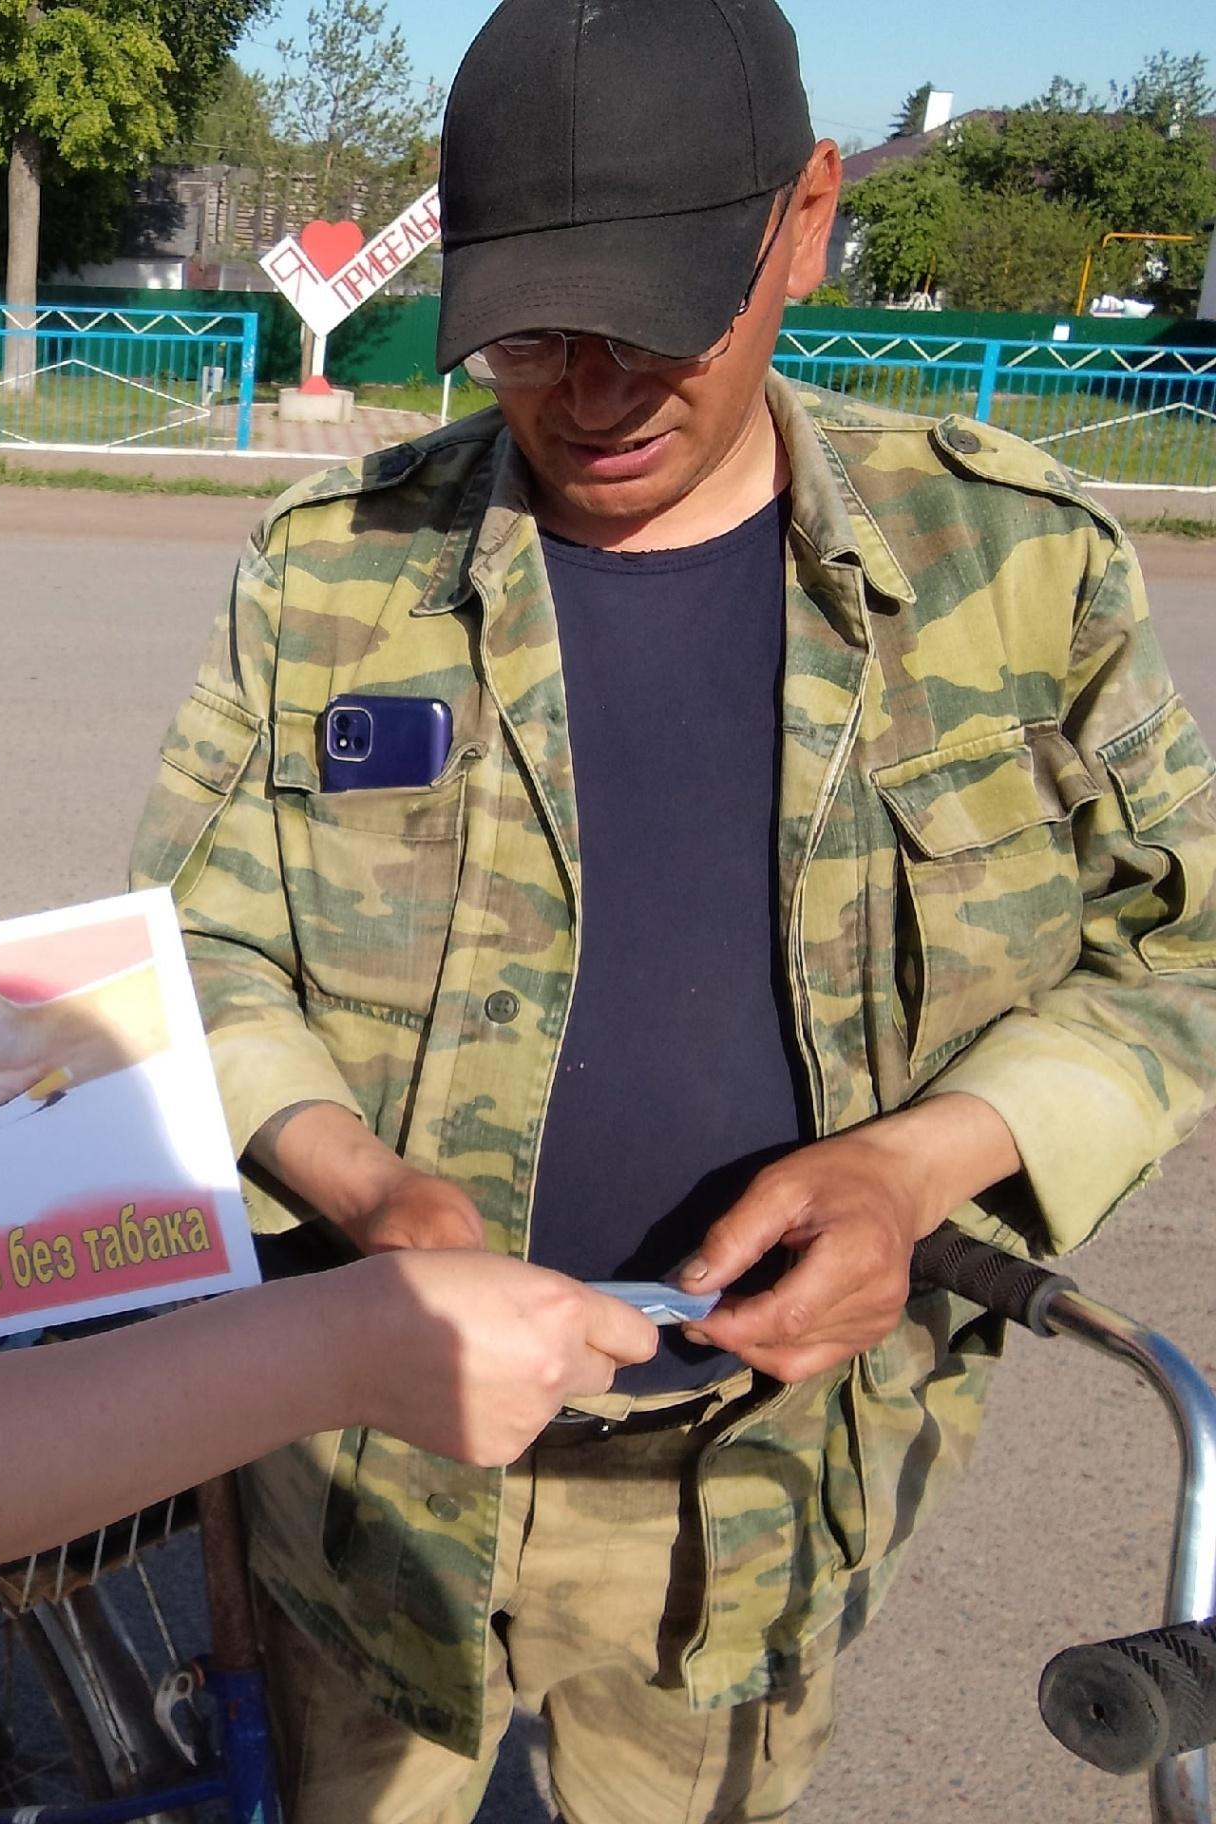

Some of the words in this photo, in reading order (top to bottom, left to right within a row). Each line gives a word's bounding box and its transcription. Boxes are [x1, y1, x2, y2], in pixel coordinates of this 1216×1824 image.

[269, 246, 319, 304] Я
[8, 1226, 76, 1288] без
[82, 1203, 211, 1272] табака
